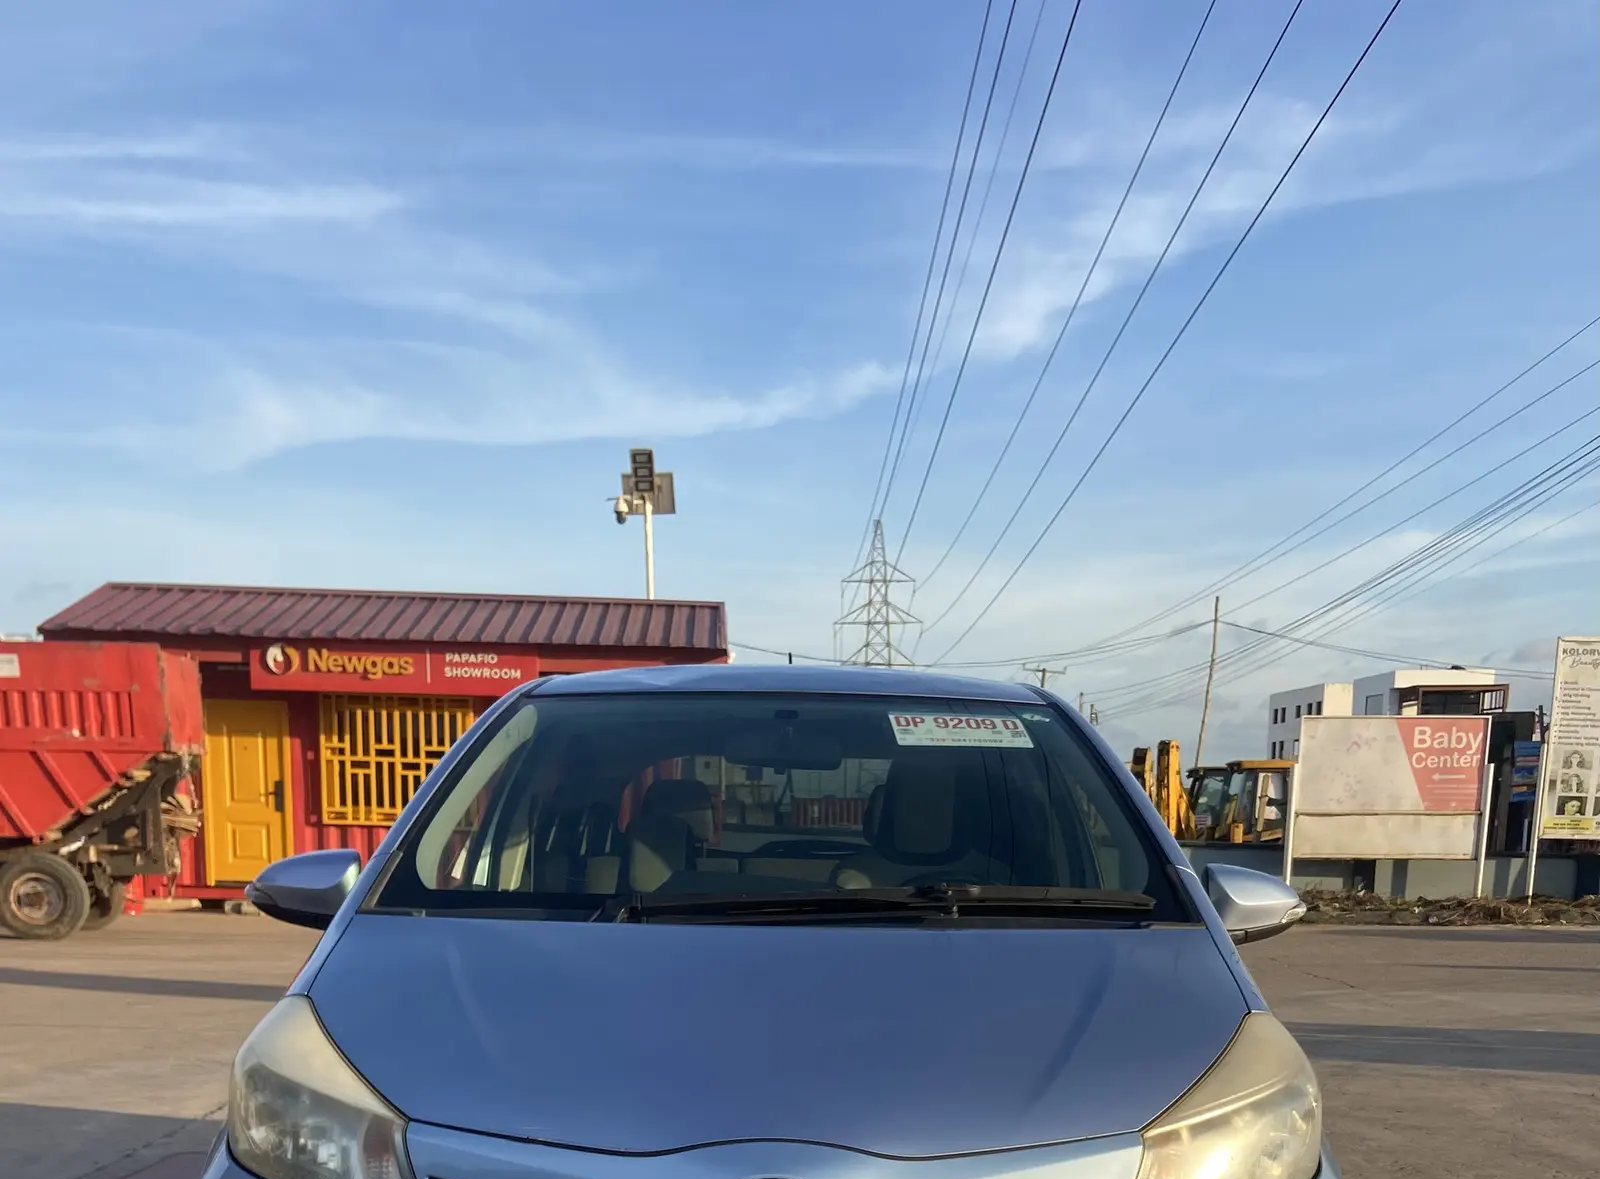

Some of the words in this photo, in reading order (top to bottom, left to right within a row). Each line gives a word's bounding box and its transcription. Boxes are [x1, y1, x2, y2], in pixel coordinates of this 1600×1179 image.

[307, 648, 414, 679] Newgas
[445, 652, 498, 664] PAPAFIO
[444, 666, 522, 680] SHOWROOM
[894, 716, 925, 728] DP
[933, 717, 997, 730] 9209
[1413, 725, 1483, 754] Baby
[1411, 752, 1481, 768] Center
